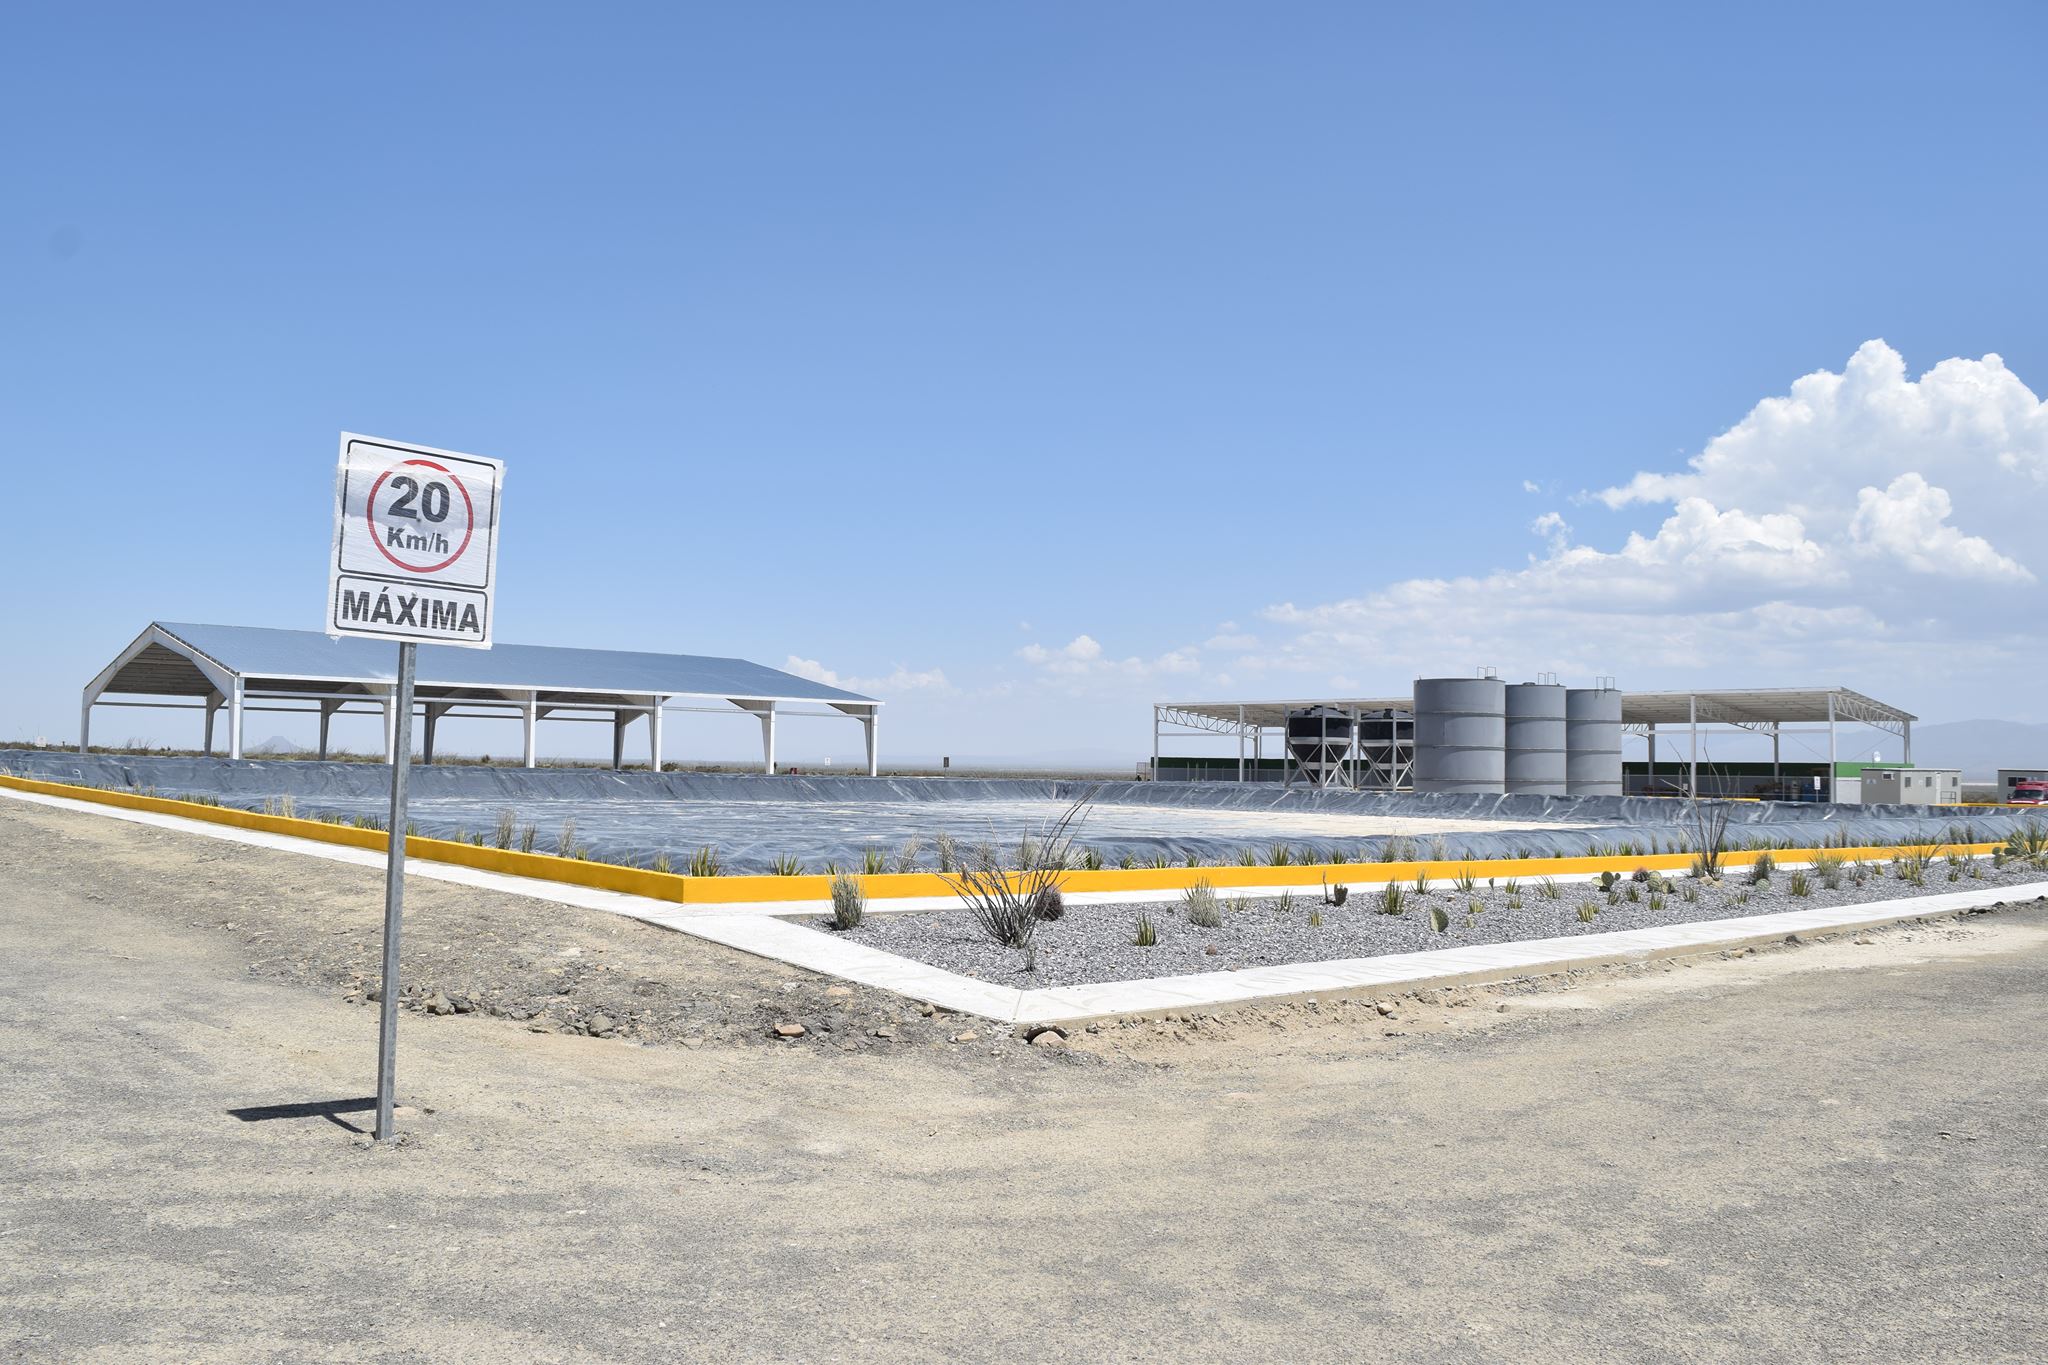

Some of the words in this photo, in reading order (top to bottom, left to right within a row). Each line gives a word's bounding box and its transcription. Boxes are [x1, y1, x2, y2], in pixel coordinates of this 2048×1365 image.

[388, 476, 450, 523] 20
[387, 526, 449, 554] Km/h
[342, 586, 480, 633] MÁXIMA
